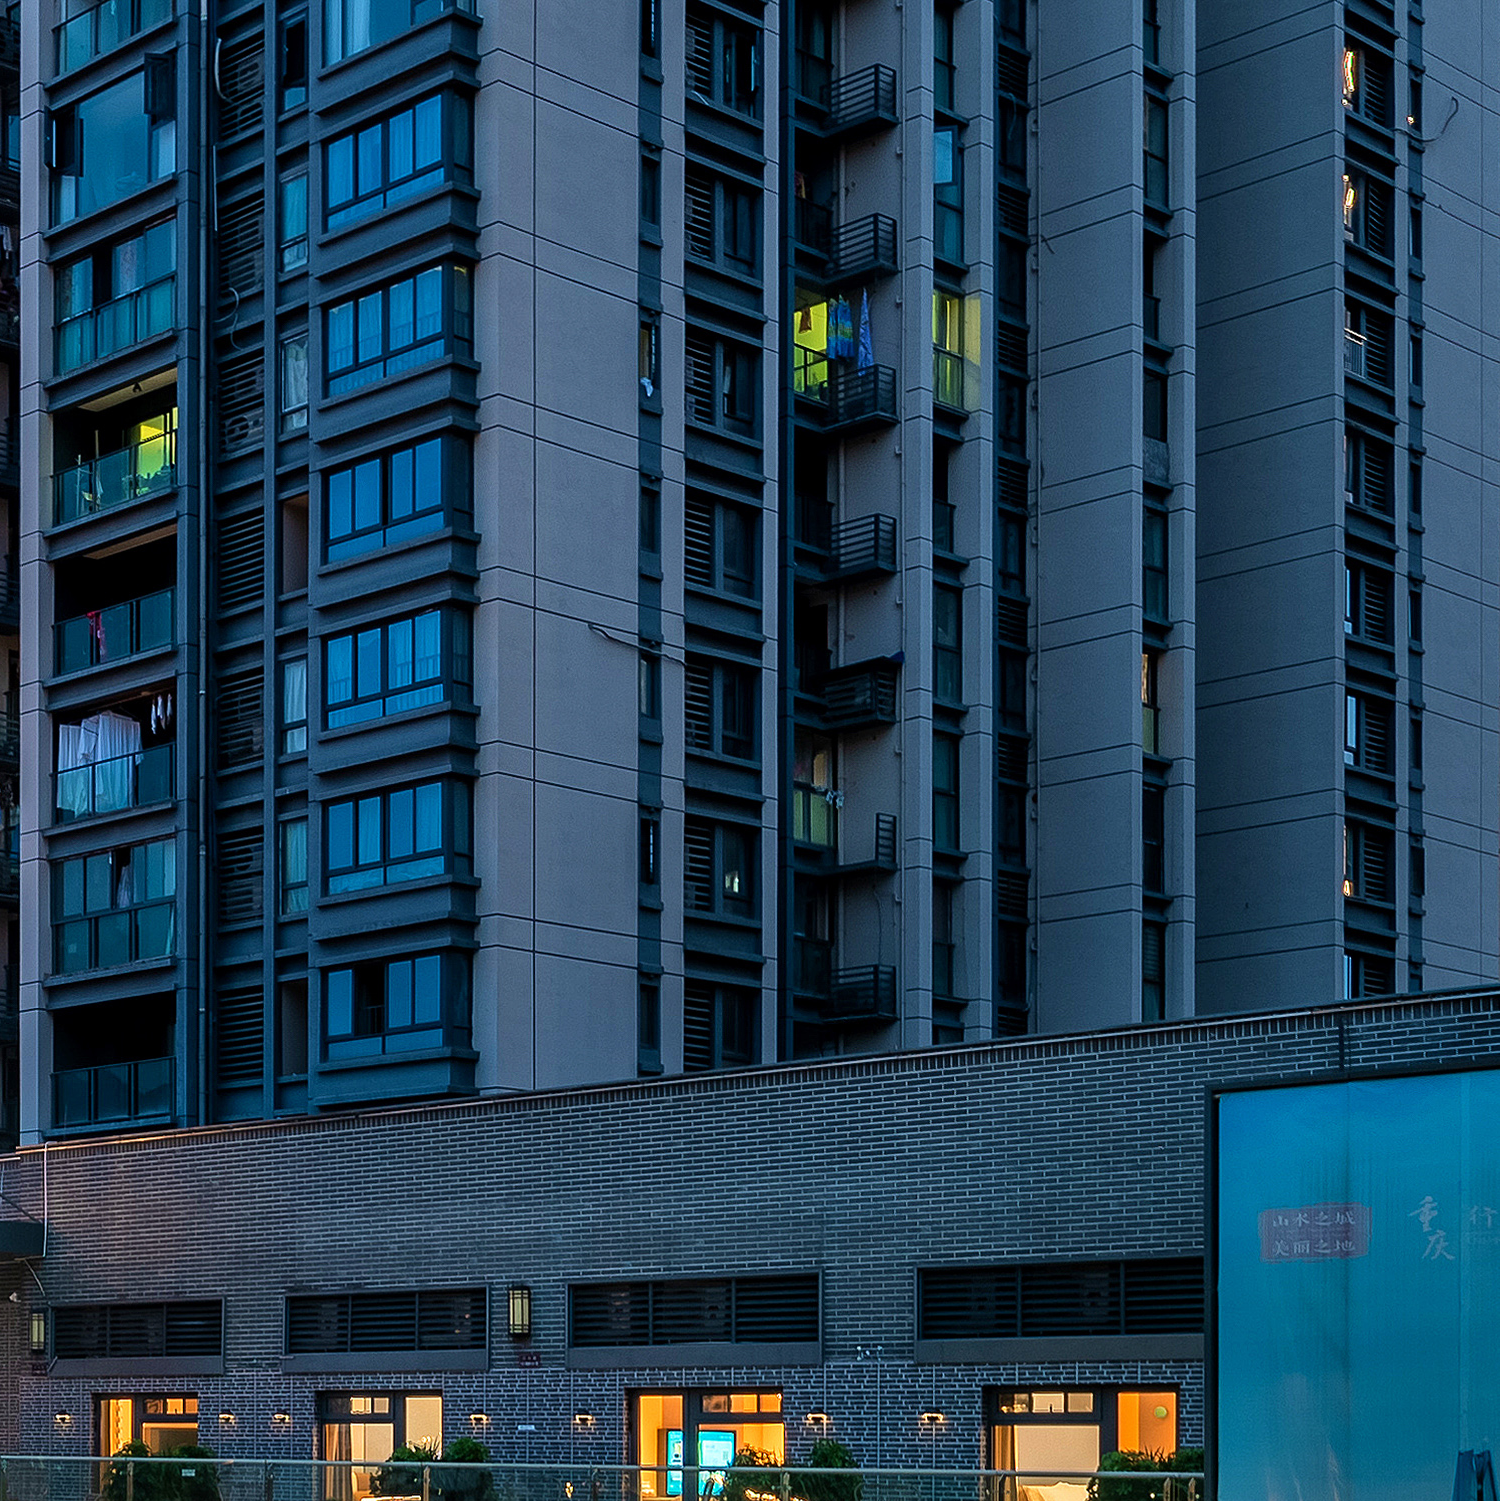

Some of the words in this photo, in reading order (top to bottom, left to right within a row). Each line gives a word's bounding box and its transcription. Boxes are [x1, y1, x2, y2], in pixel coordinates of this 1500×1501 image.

[1272, 1210, 1356, 1228] 山水之城
[1409, 1196, 1456, 1261] 重庆
[1272, 1238, 1356, 1257] 美丽之地
